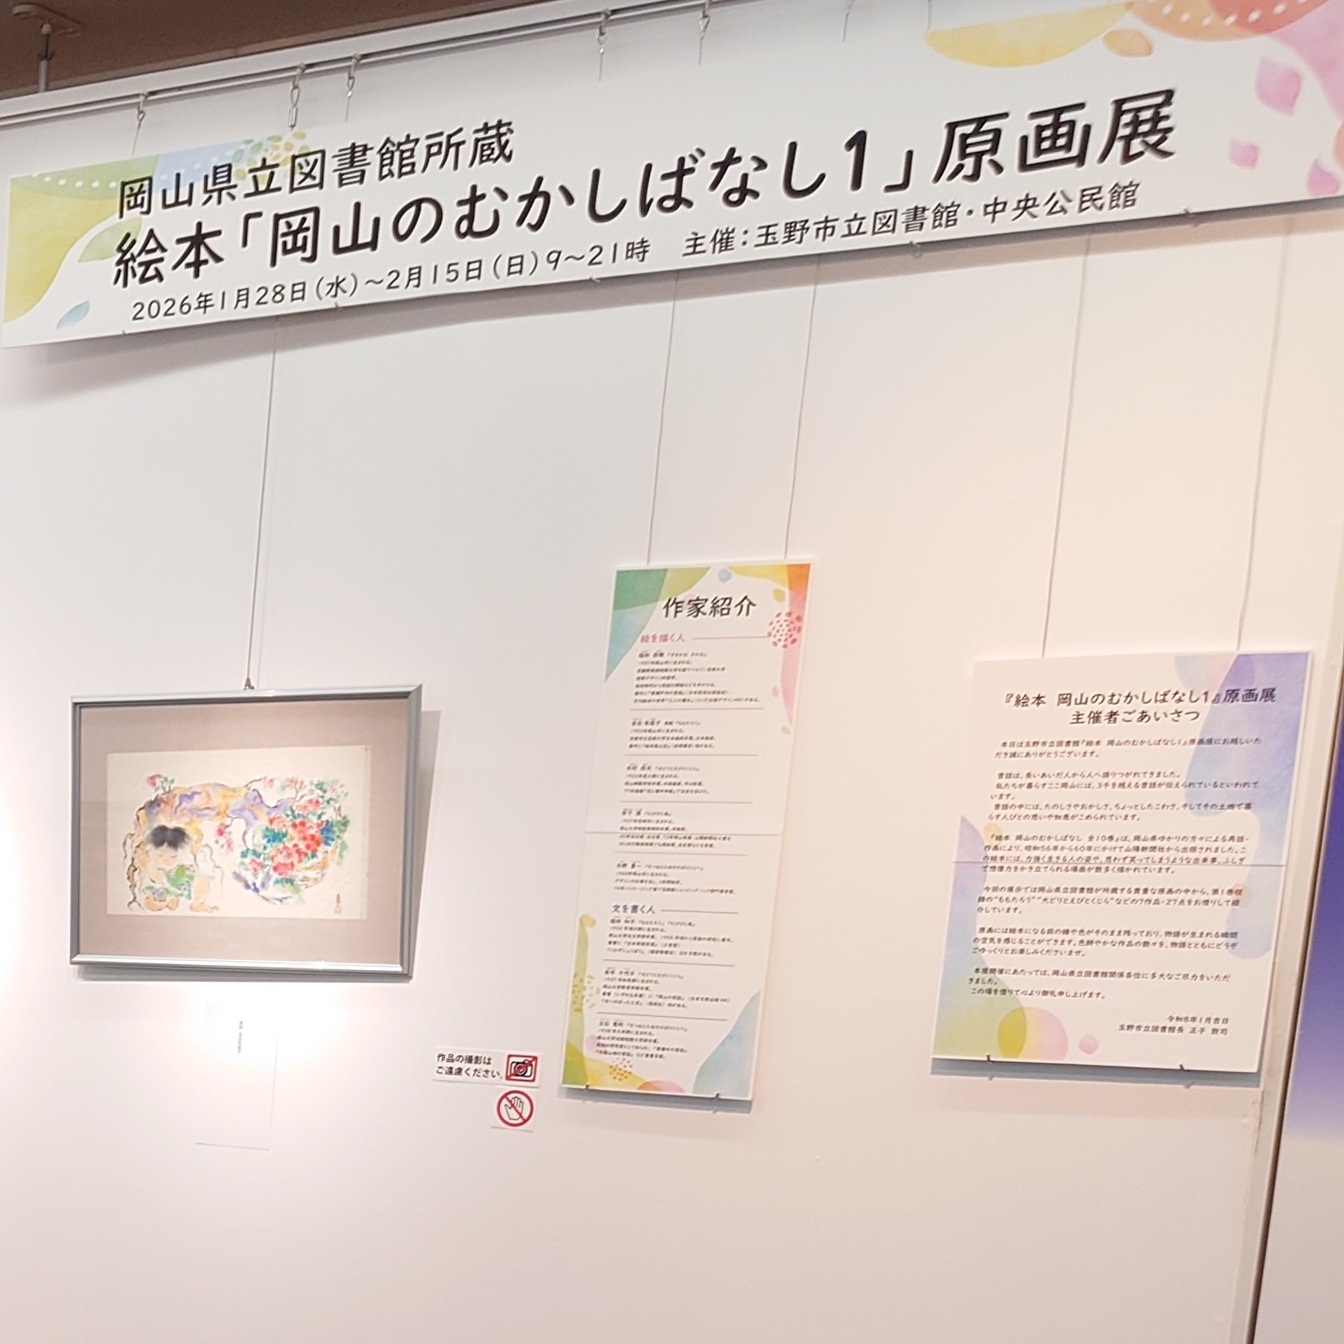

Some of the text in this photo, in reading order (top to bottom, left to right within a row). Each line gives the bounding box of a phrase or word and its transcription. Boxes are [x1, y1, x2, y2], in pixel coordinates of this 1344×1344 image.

[116, 118, 515, 220] 岡山県立図書館所蔵
[111, 88, 1178, 290] 絵本「岡山のむかしばなし1」原画展
[662, 595, 757, 619] 作家紹介
[1070, 709, 1200, 725] 主催者ごあいさつ
[990, 792, 1015, 800] います。
[612, 904, 656, 914] 文を書く人
[437, 1053, 493, 1065] 作品の撮影は
